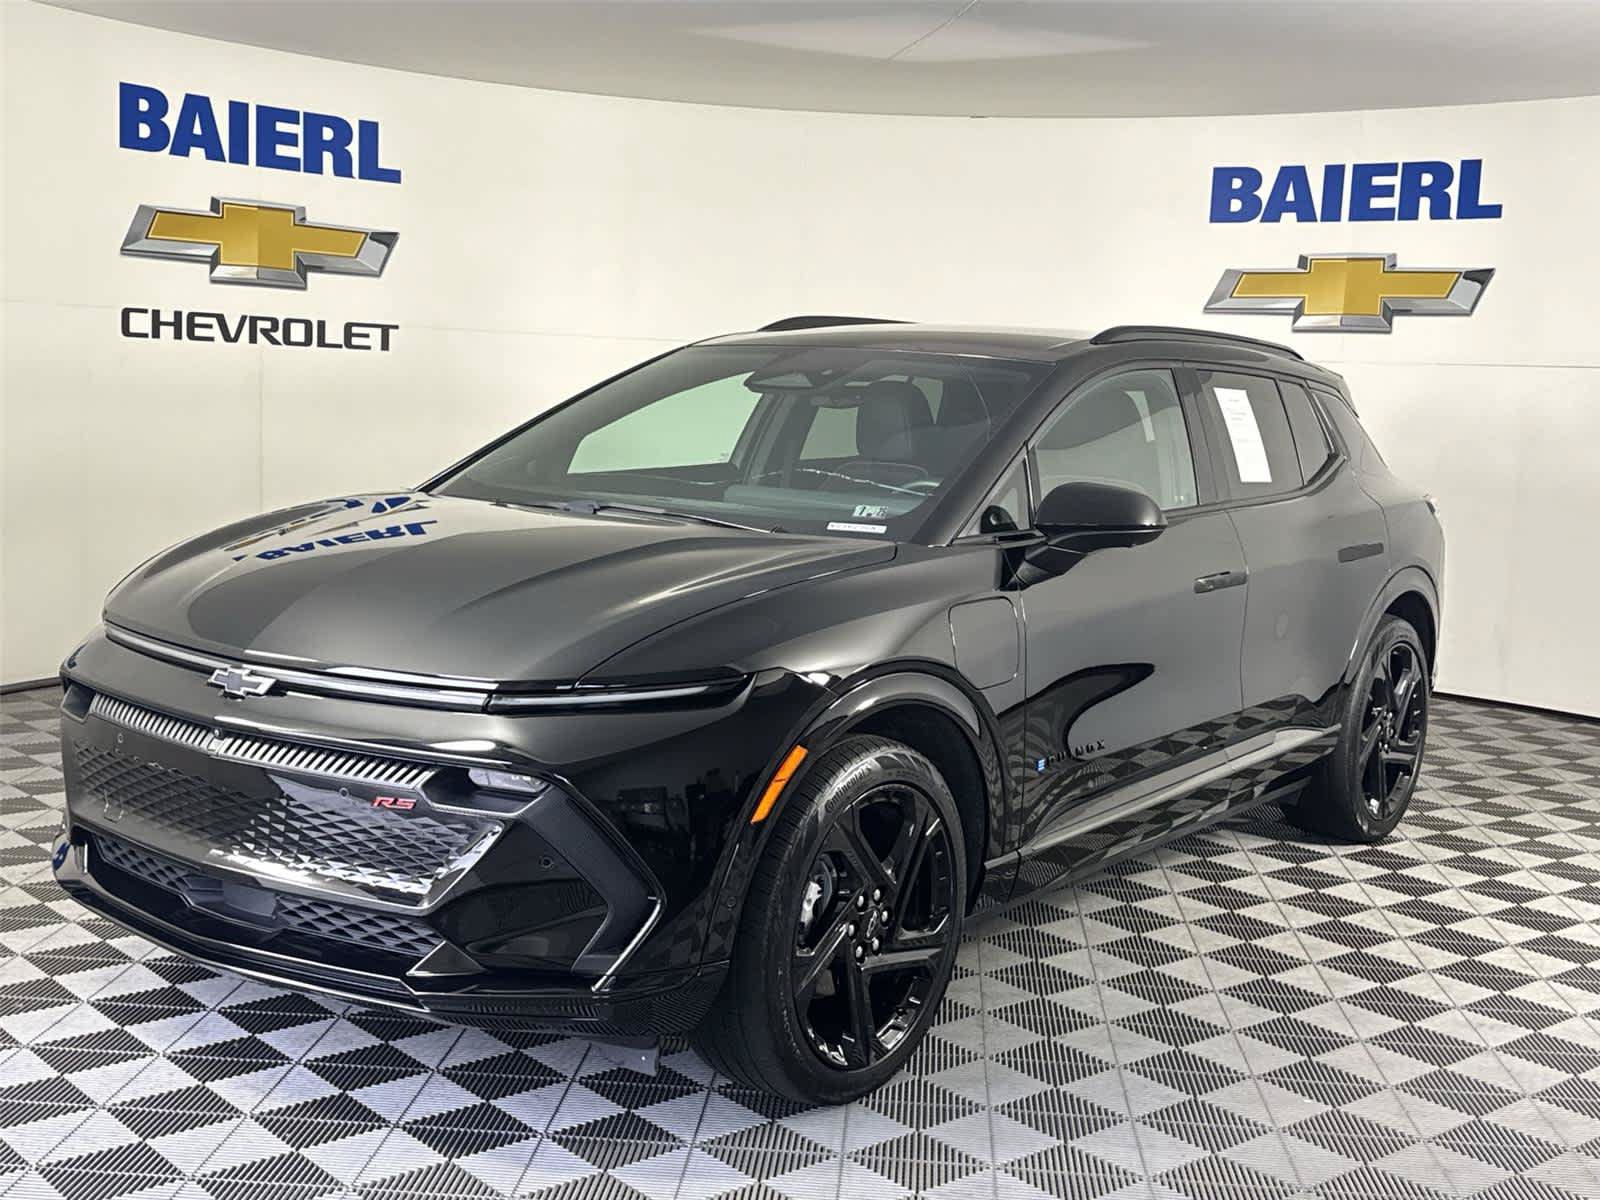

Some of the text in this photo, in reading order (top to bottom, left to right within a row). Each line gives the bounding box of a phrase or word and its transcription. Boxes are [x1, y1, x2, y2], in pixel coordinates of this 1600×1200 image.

[119, 81, 402, 184] BAIERL
[1209, 158, 1503, 223] BAIERL
[121, 307, 399, 351] CHEVROLET
[371, 796, 417, 810] RS
